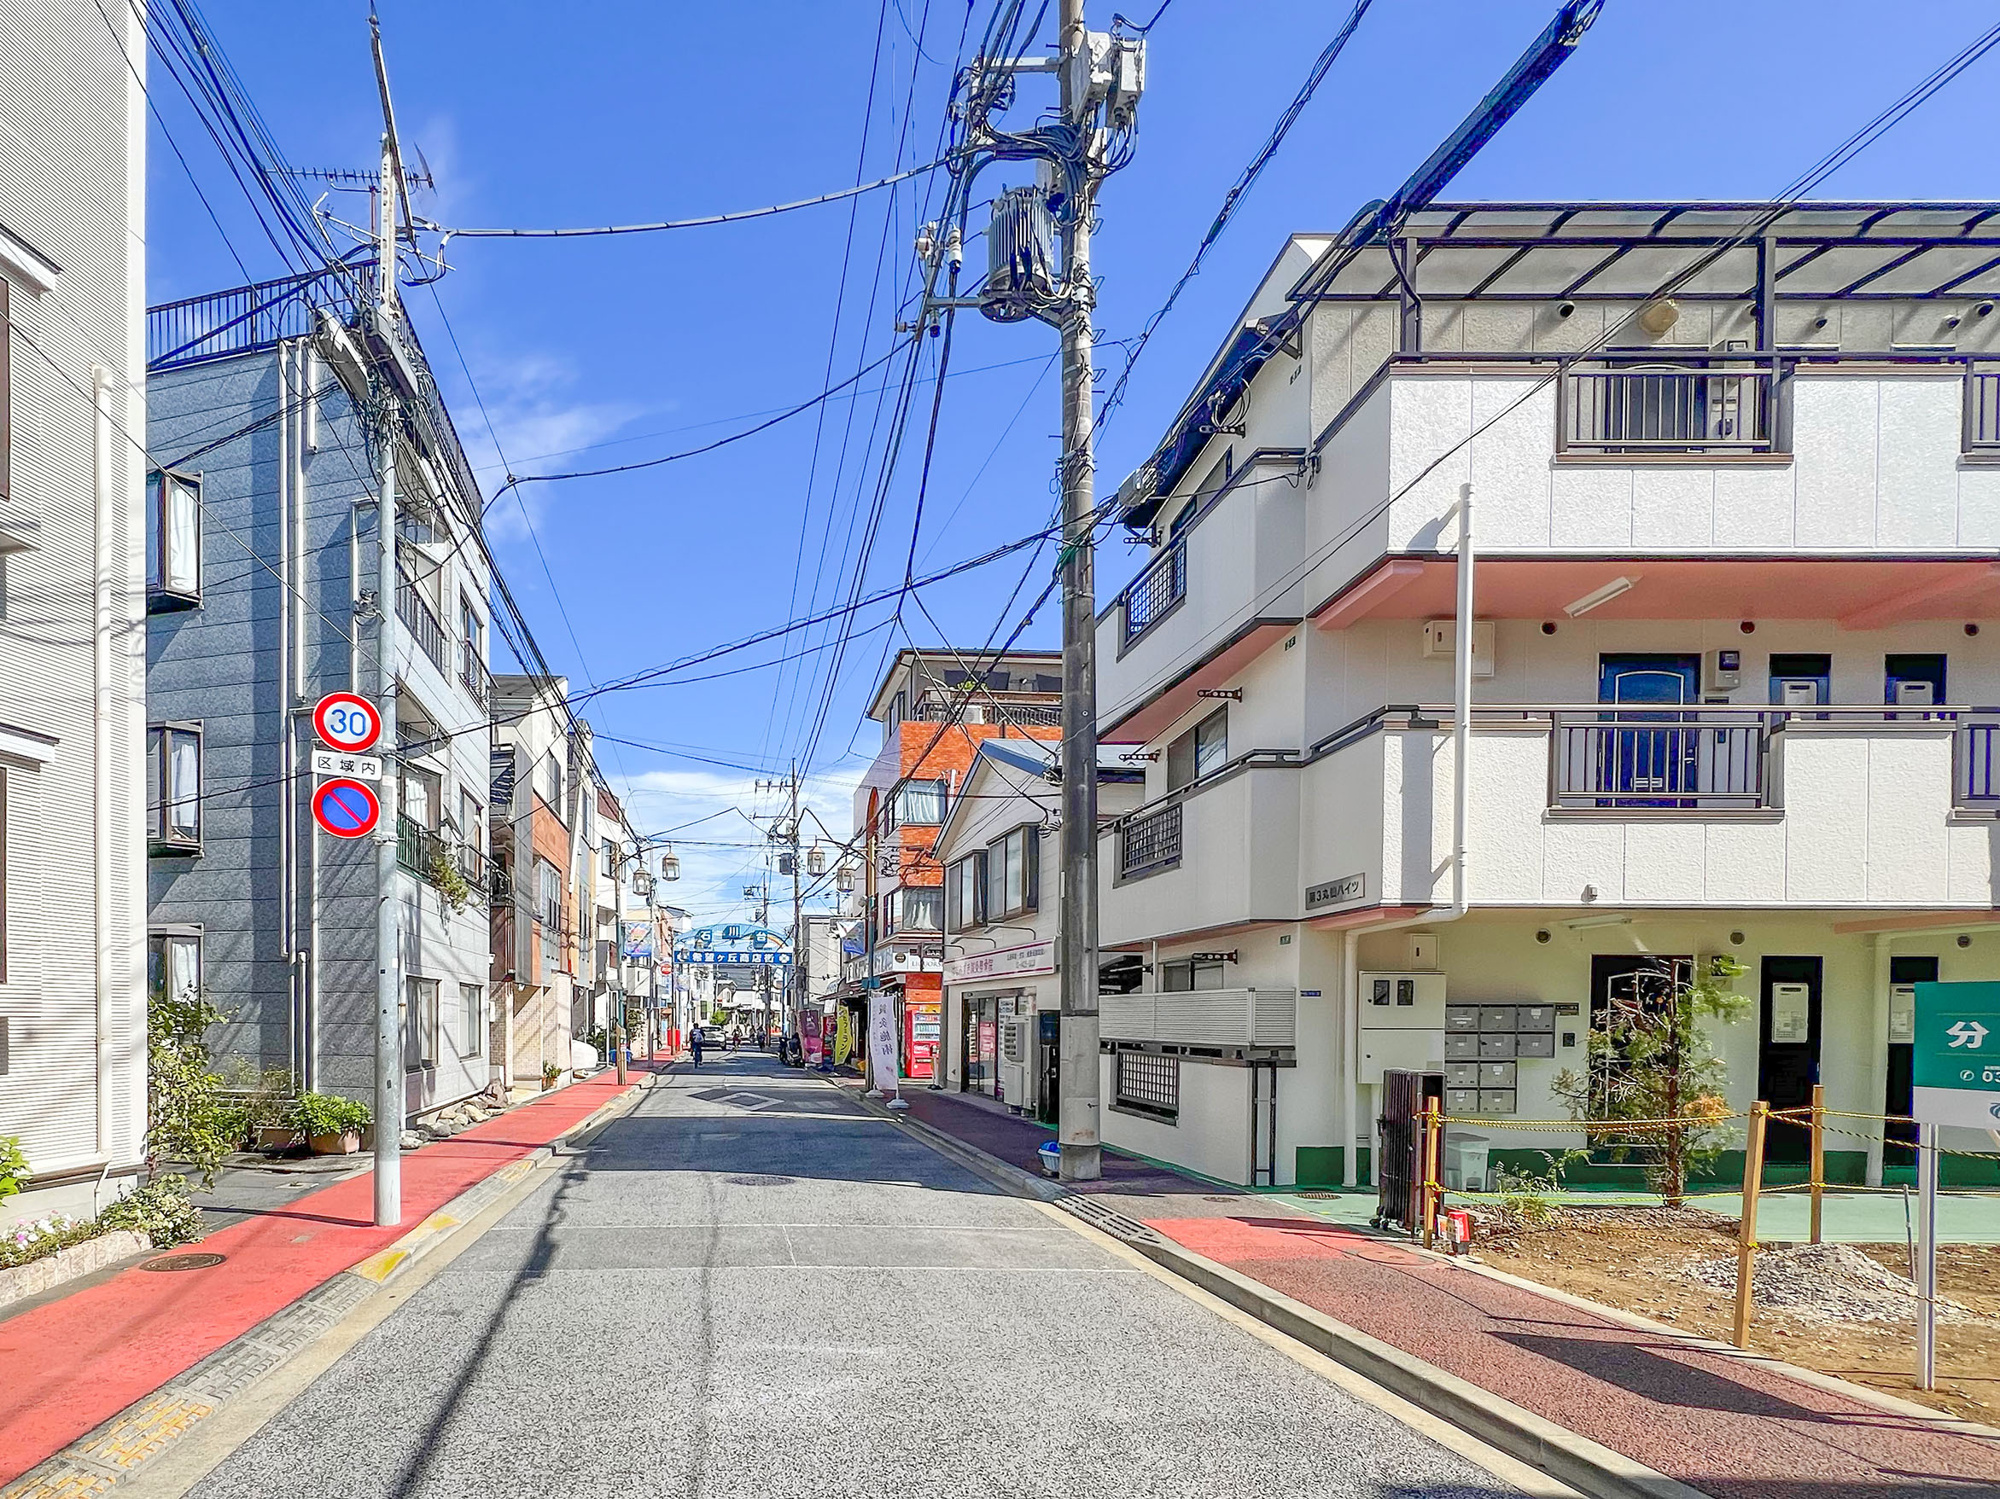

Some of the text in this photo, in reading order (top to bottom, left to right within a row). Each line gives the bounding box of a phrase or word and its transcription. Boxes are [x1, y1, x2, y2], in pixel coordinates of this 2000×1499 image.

[330, 708, 367, 737] 30
[317, 756, 376, 775] 区域内
[1945, 1020, 1990, 1049] 分
